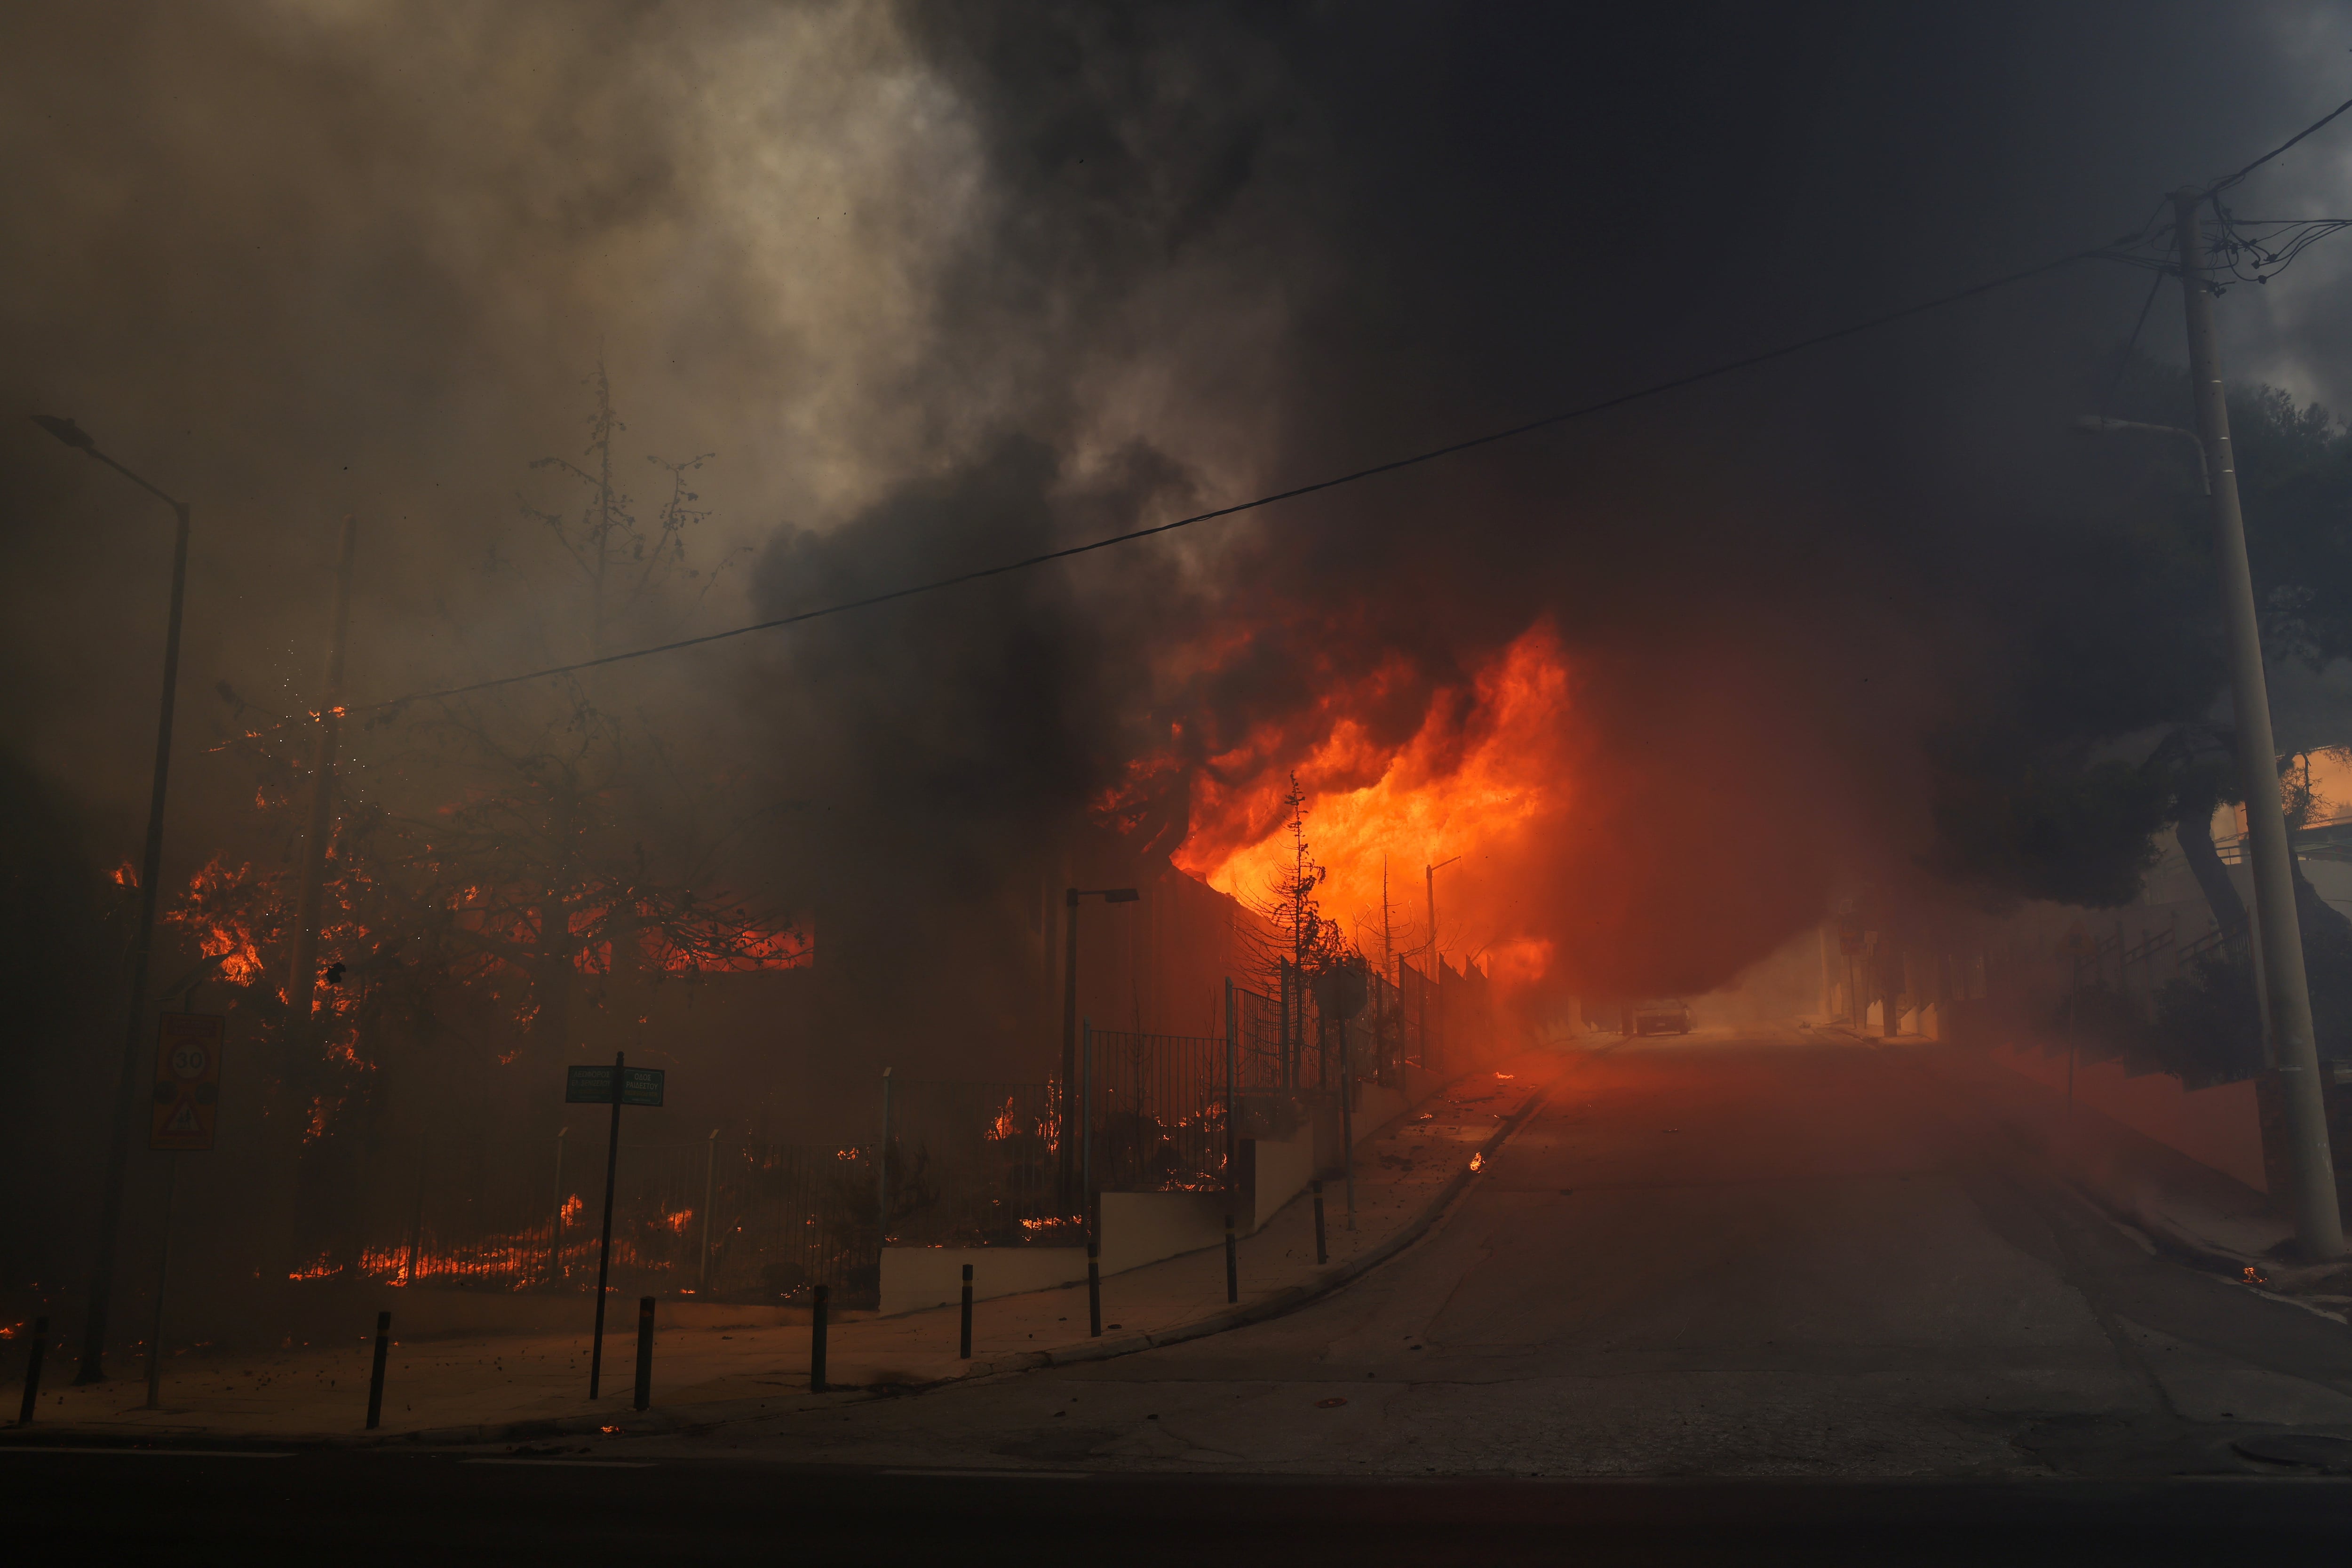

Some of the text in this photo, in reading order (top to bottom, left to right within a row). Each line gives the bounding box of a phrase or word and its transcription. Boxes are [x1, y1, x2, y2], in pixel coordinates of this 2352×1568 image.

[175, 1052, 203, 1069] 30
[634, 1073, 652, 1081] ΟΔΟΣ
[626, 1081, 658, 1090] ΡΑΙΔΕΣΤΟΥ
